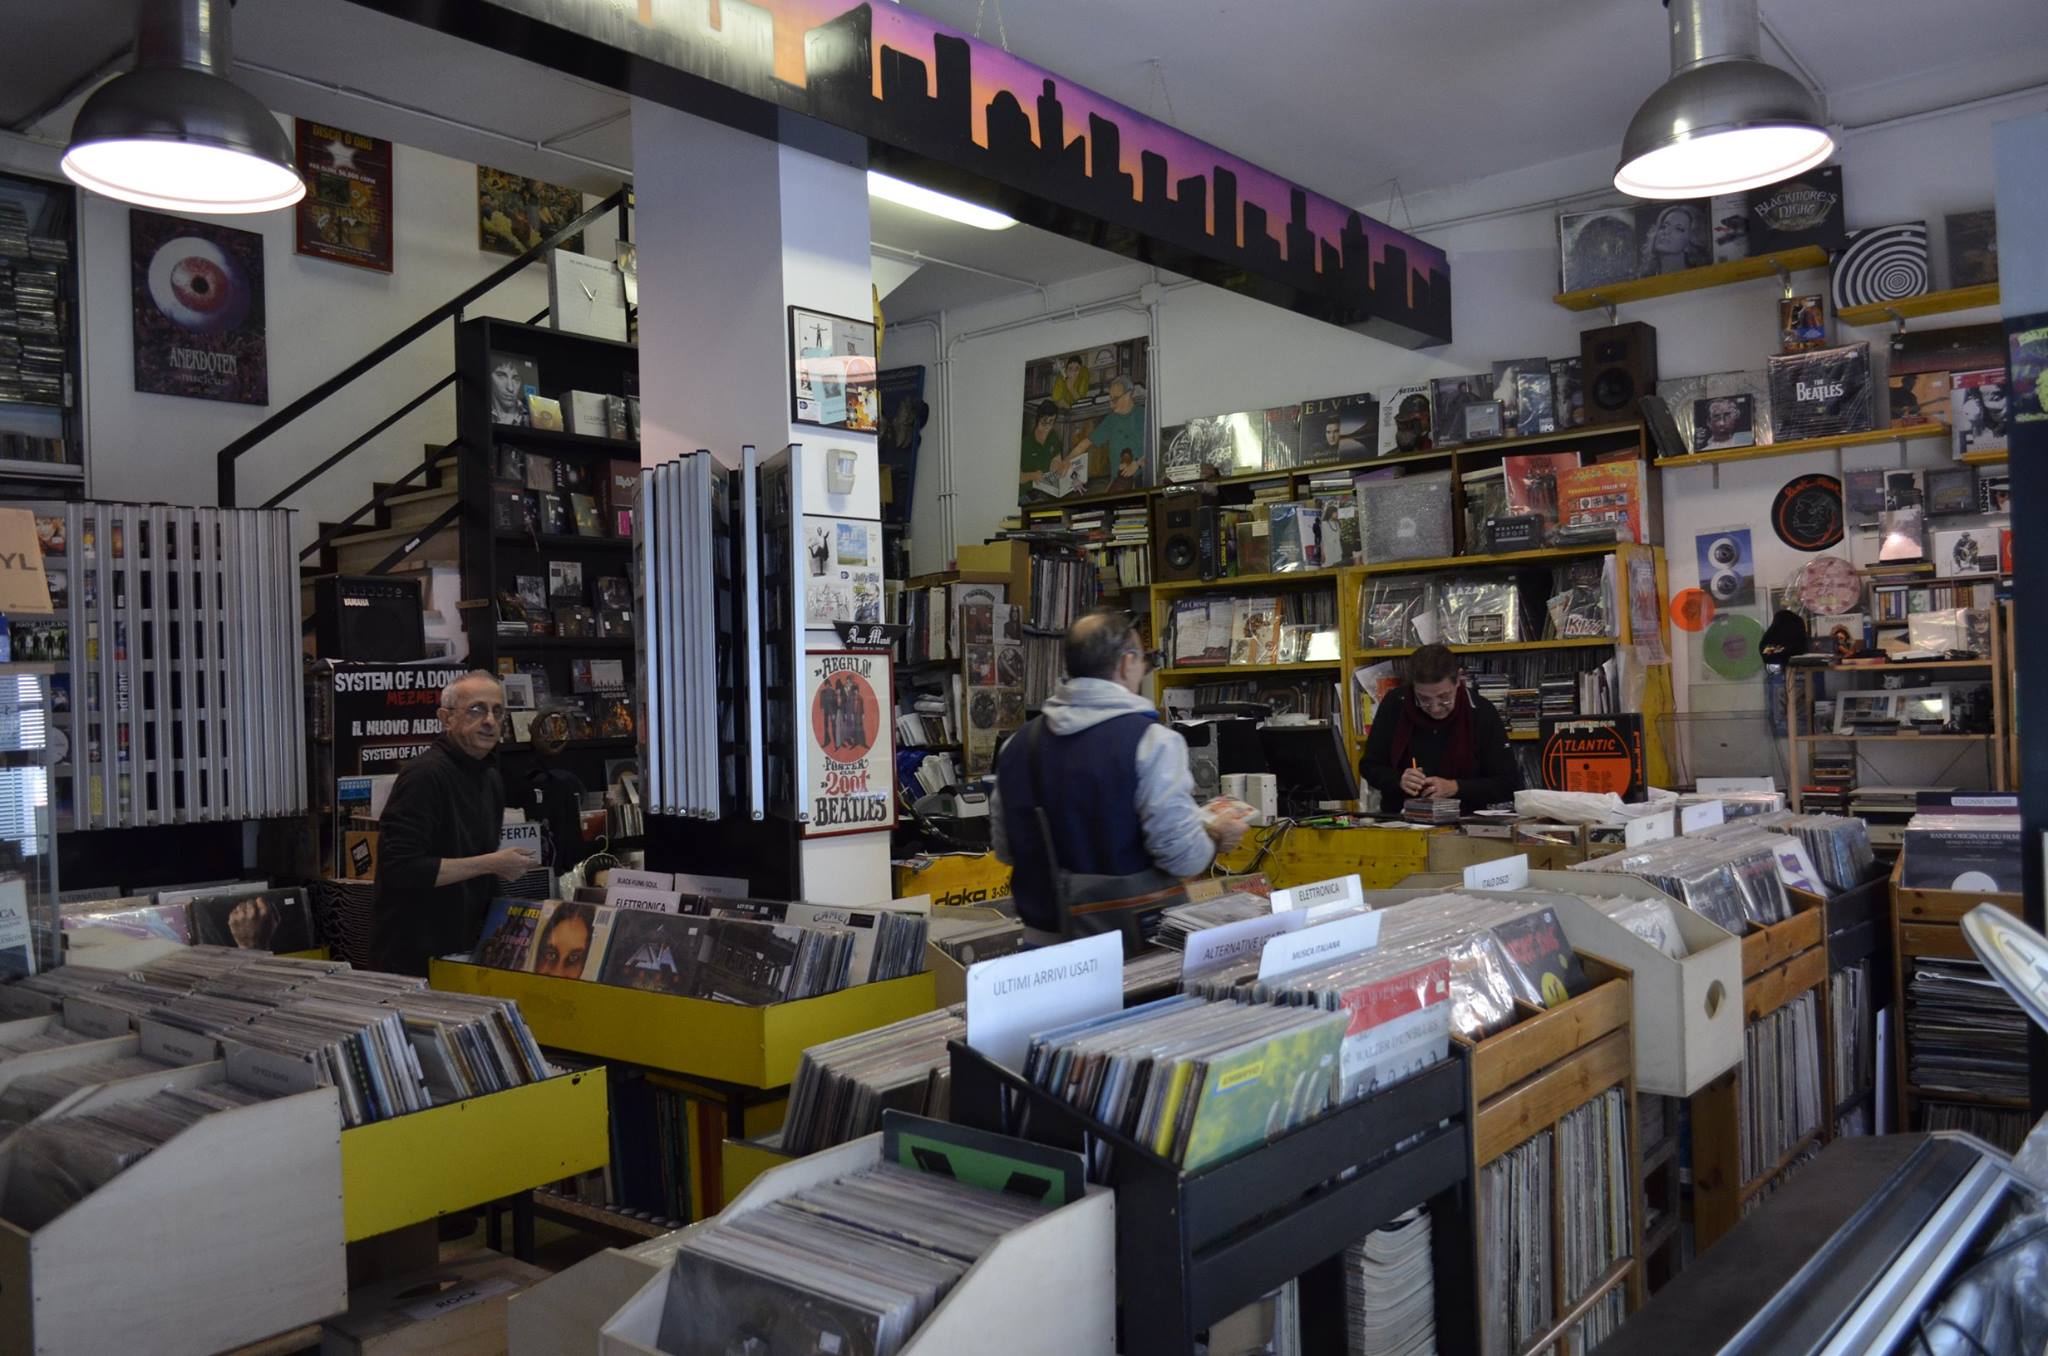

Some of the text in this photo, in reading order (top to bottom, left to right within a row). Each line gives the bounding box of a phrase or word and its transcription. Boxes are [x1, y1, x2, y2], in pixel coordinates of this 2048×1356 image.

[168, 347, 238, 376] ANEKDOTEN
[1795, 381, 1844, 402] BEATLES
[335, 671, 392, 692] SYSTEM
[395, 670, 414, 690] OF
[415, 670, 426, 689] A
[352, 718, 442, 737] IL NUOVO ALBU
[362, 747, 398, 761] SYSTEM
[399, 746, 410, 758] OF
[815, 795, 887, 827] BEATLES
[1298, 882, 1341, 902] ELETTRONICA
[616, 897, 667, 913] ELETTRONICA
[1202, 936, 1259, 961] ALTERNATIVE
[993, 957, 1099, 996] ULTIMI ARRIVI USATI
